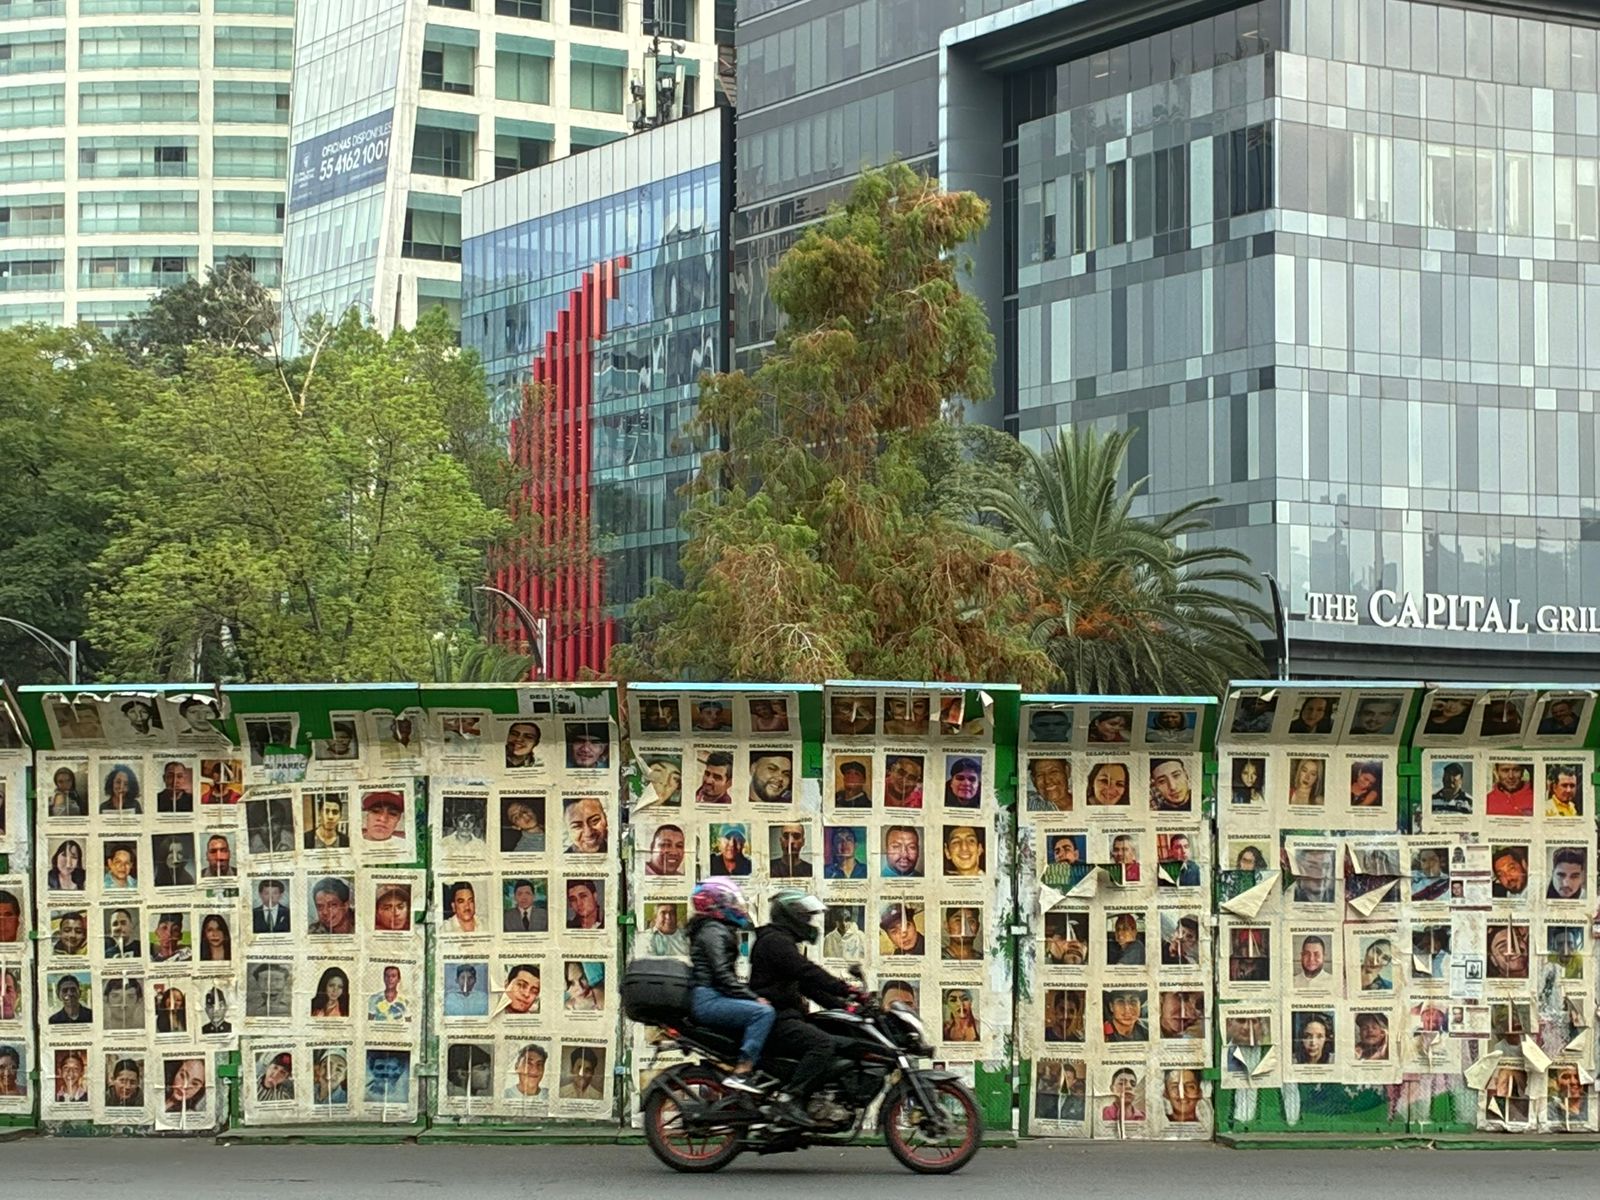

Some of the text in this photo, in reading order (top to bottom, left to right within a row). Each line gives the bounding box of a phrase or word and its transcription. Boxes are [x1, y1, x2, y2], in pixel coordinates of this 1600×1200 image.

[319, 157, 334, 181] 55
[334, 147, 361, 175] 4162
[362, 137, 389, 167] 1001
[1306, 592, 1358, 621] THE
[1369, 589, 1529, 634] CAPITAL
